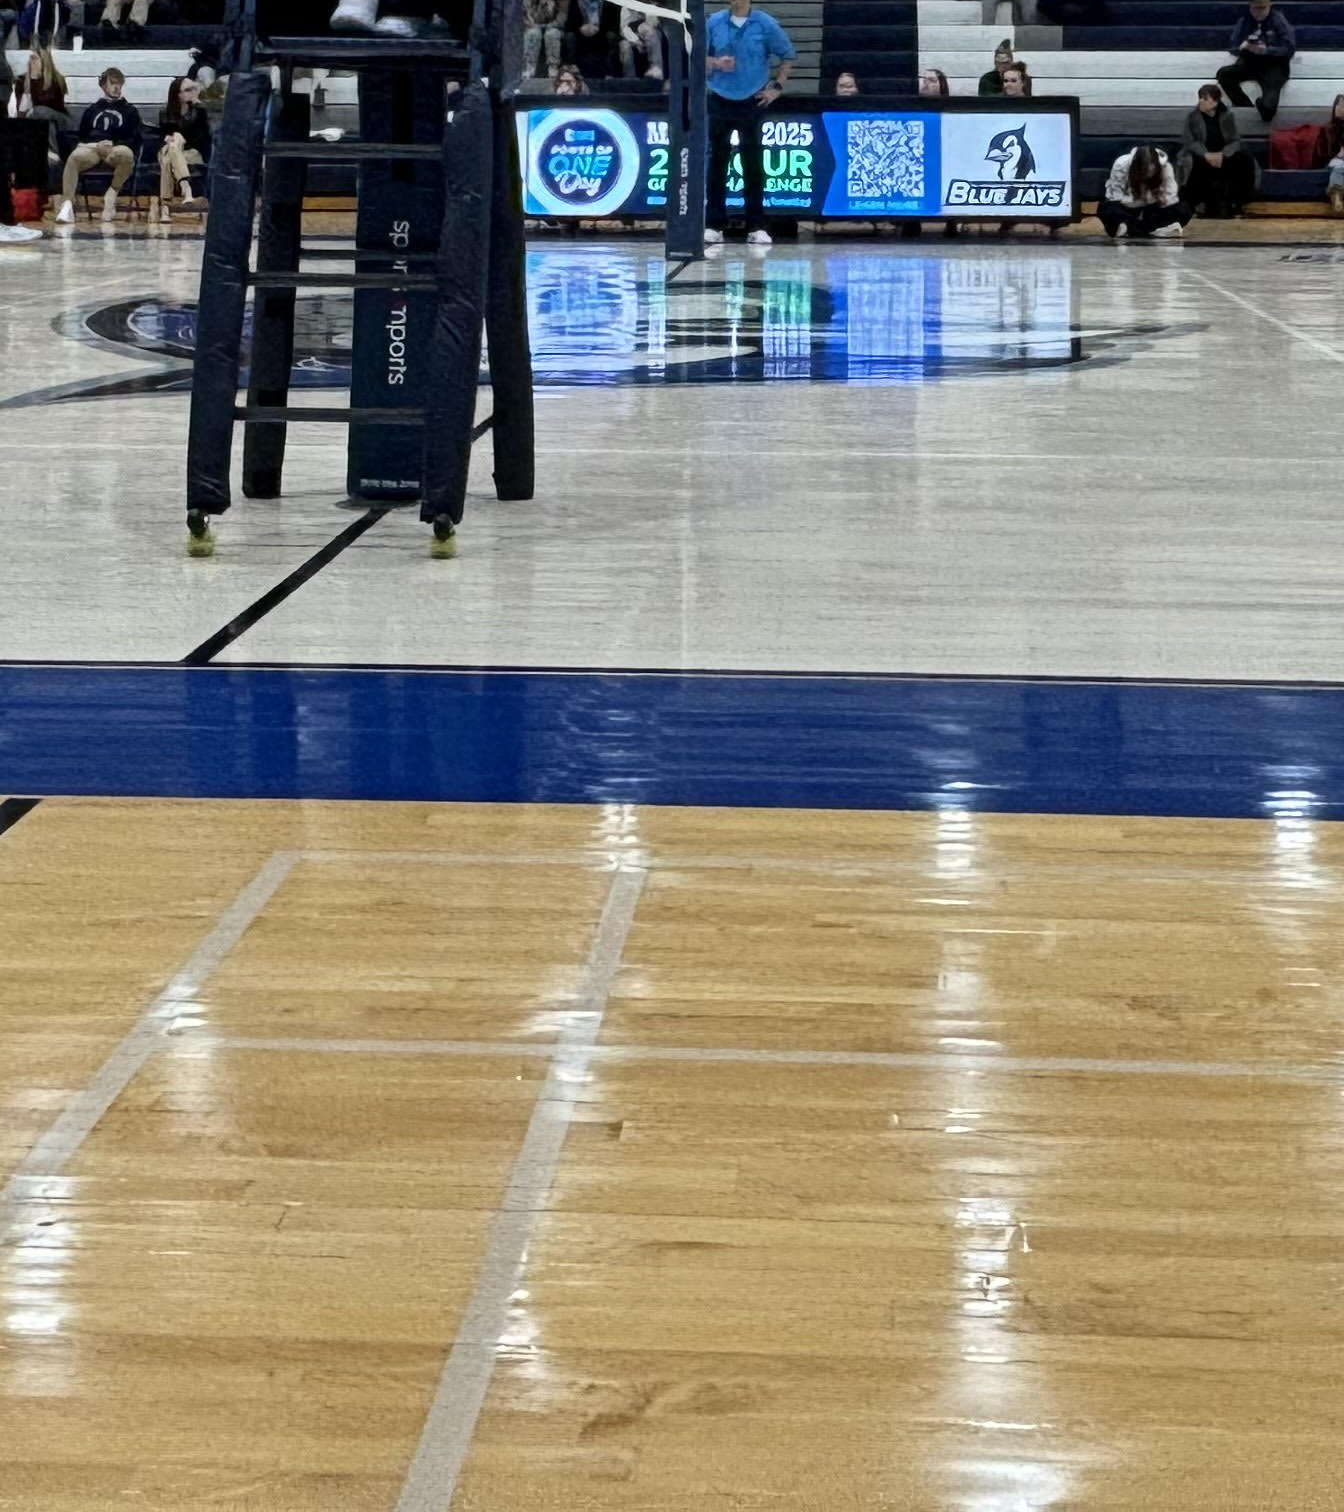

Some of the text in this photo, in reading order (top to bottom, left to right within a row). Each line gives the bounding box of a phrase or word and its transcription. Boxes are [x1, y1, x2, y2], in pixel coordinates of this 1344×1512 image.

[761, 121, 814, 146] 2025
[549, 155, 613, 176] ONE
[949, 181, 1061, 205] BLUE JAYS
